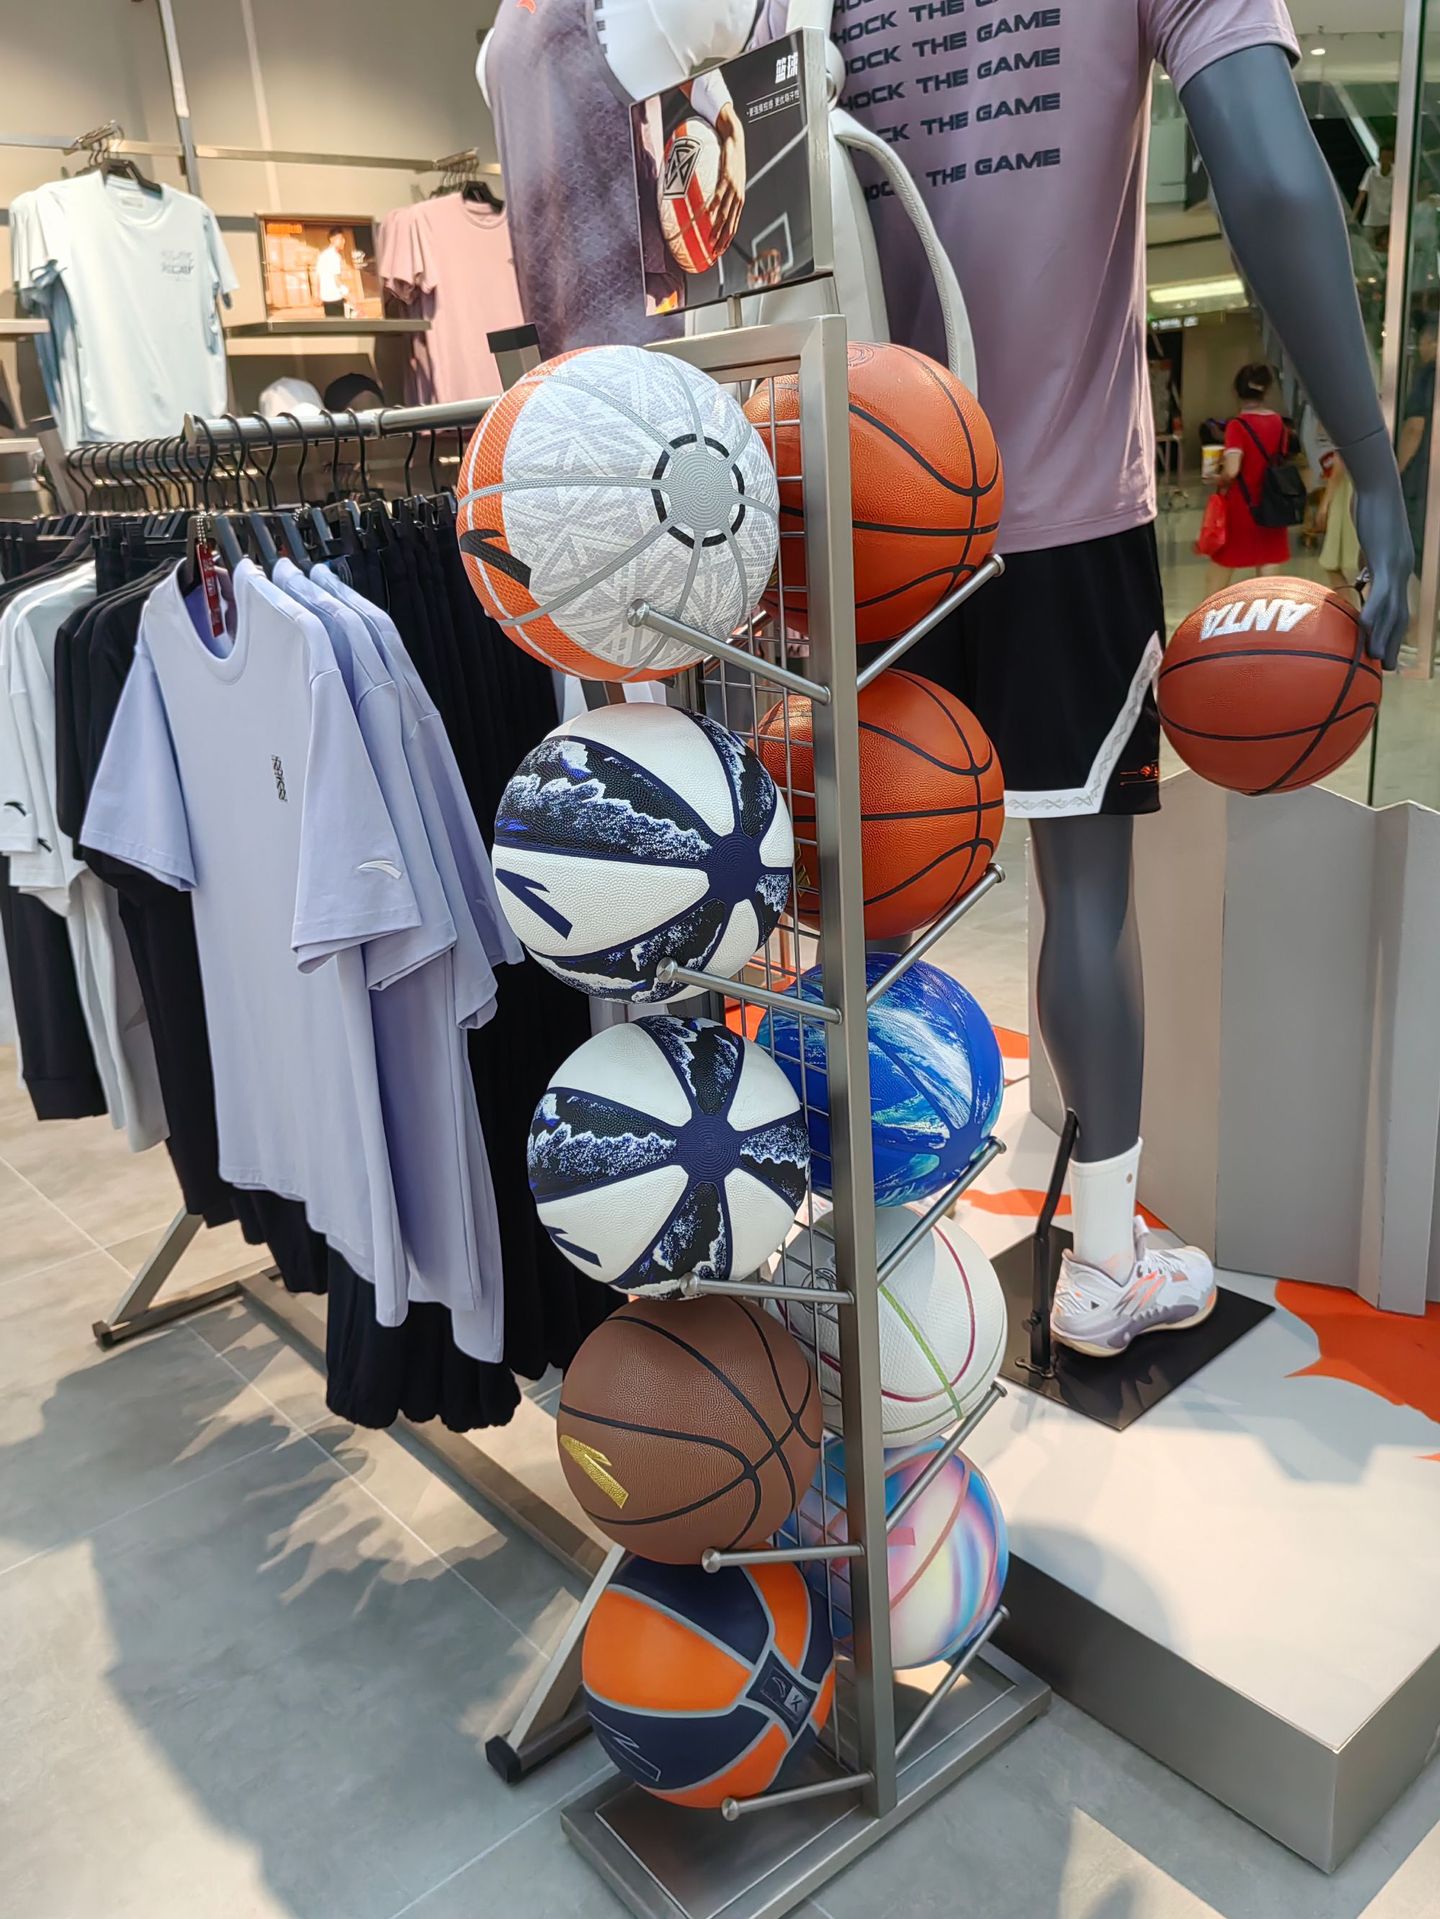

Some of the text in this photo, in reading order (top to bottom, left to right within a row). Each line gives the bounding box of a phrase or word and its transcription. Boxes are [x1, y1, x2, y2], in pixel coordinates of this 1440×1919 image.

[831, 10, 898, 44] HOCK
[908, 0, 965, 23] THE
[845, 8, 1061, 76] OCK THE GAME
[775, 52, 798, 84] 篮球
[839, 47, 1061, 111] HOCK THE GAME
[921, 111, 969, 136] THE
[976, 93, 1061, 122] GAME
[926, 148, 1061, 187] THE GAME
[1200, 598, 1316, 642] ANTA
